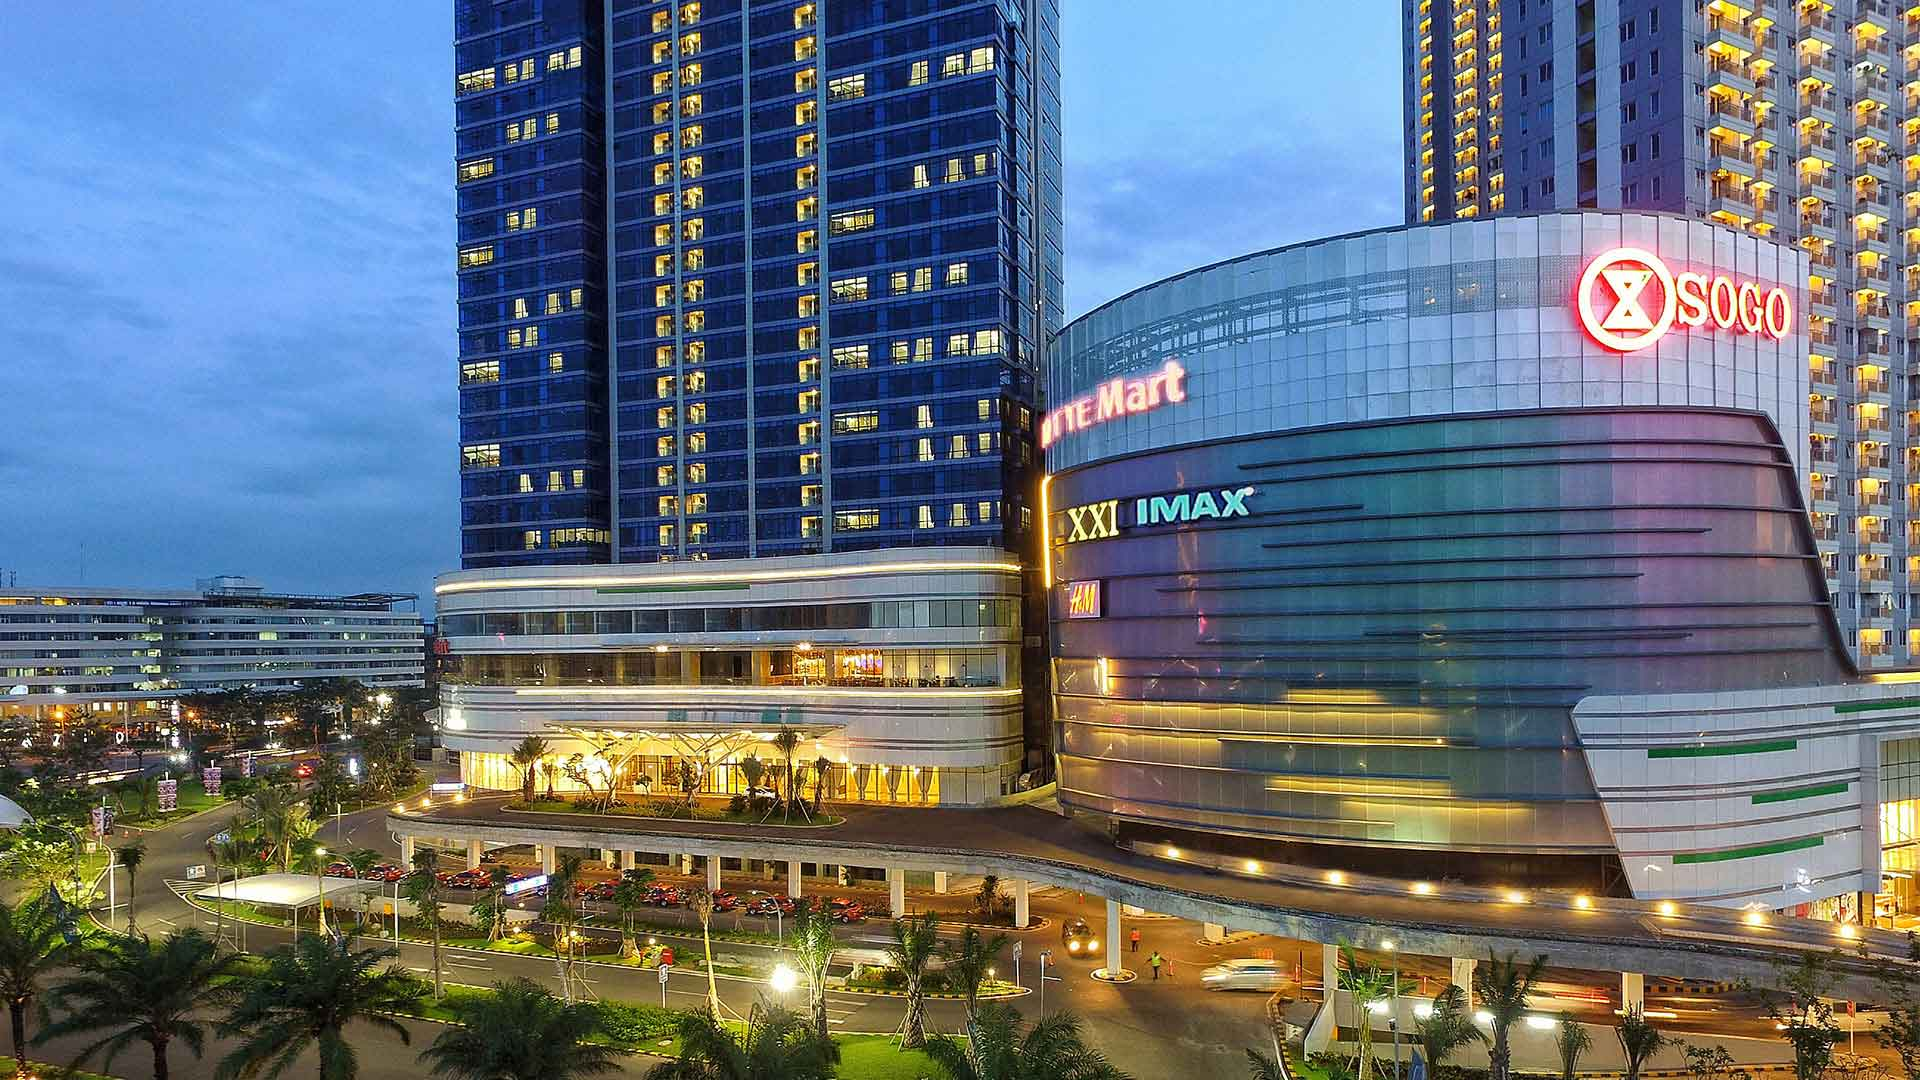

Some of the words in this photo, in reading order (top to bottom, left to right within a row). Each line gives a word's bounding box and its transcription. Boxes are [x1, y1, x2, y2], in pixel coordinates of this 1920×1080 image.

[1677, 271, 1791, 339] SOGO
[1097, 359, 1186, 420] Mart
[1067, 500, 1119, 542] XXI
[1137, 487, 1254, 526] IMAX
[1070, 583, 1096, 615] H&M
